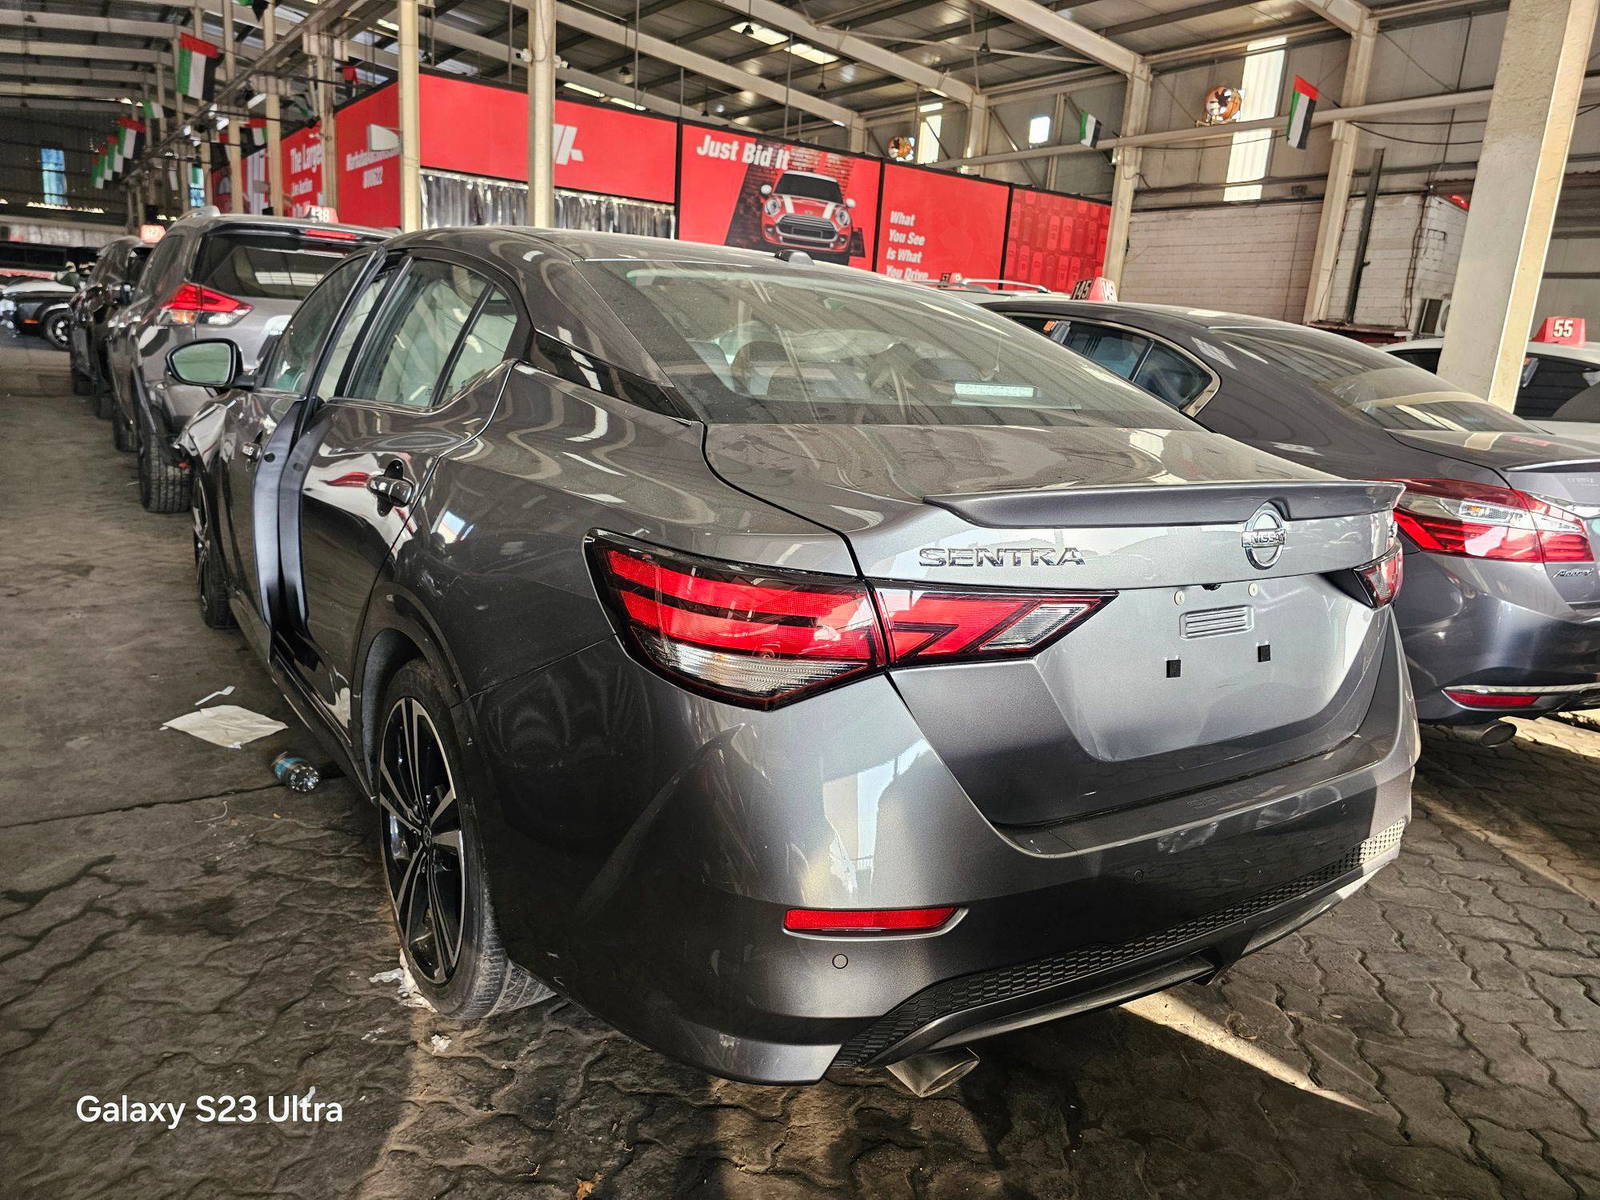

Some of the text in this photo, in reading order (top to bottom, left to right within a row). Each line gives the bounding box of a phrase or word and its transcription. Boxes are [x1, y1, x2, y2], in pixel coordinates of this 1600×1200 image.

[290, 147, 302, 175] The
[696, 135, 790, 171] Just Bid It
[890, 209, 915, 227] What
[889, 228, 925, 247] You See
[886, 247, 923, 264] Is What
[886, 265, 929, 281] You Drive
[1072, 280, 1093, 300] 145
[1552, 319, 1574, 338] 55
[919, 547, 1086, 567] SENTRA
